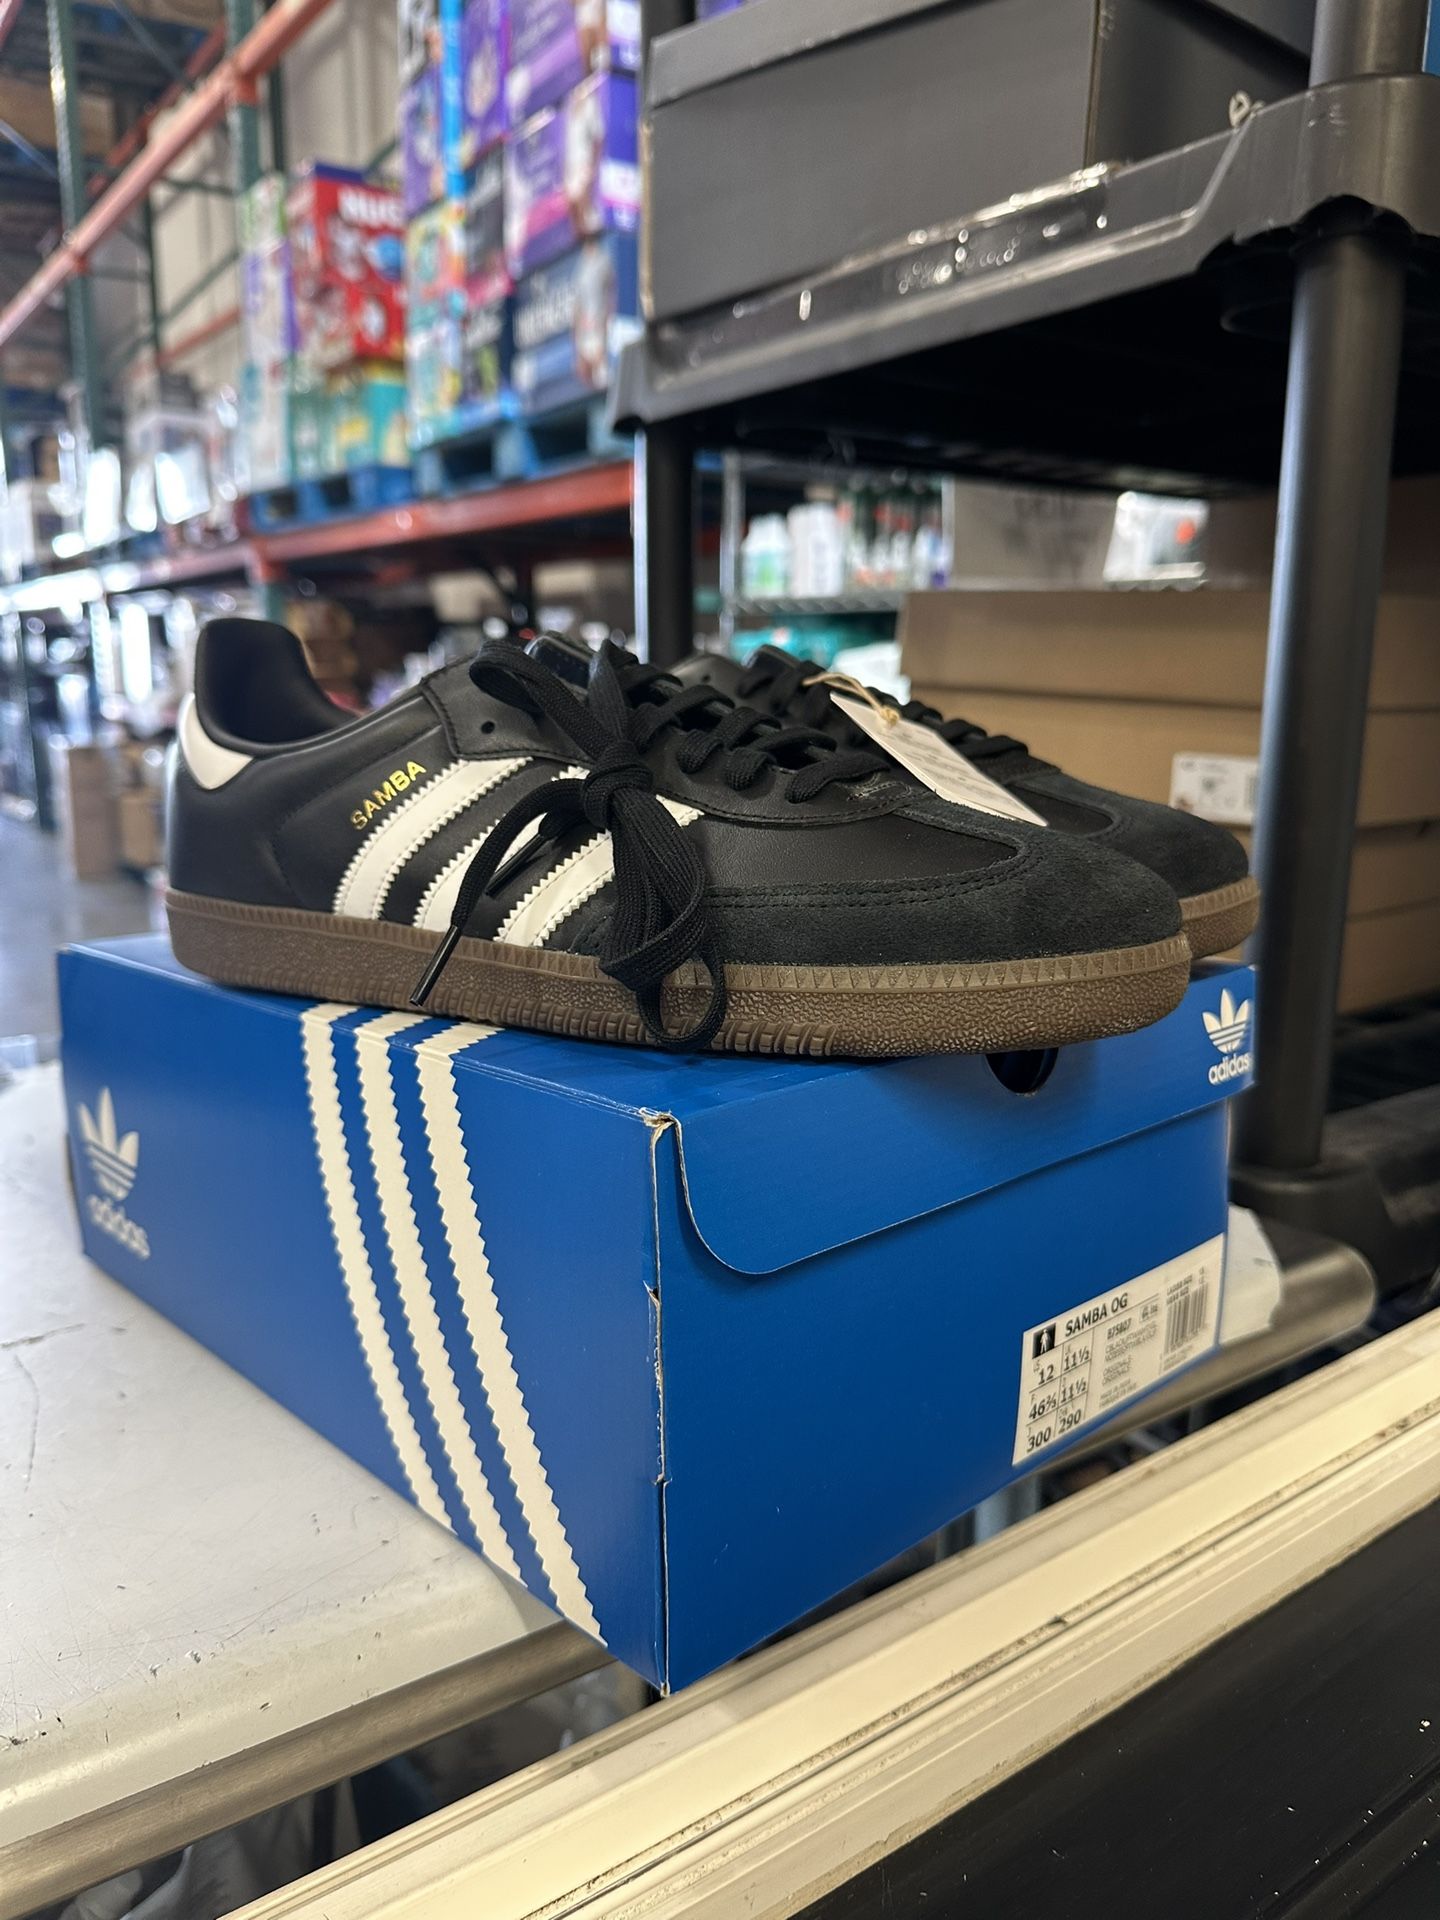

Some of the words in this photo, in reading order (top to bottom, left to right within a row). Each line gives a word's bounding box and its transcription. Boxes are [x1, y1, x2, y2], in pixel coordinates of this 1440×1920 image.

[351, 761, 427, 830] SAMBA
[1208, 1053, 1251, 1085] adidas
[88, 1194, 151, 1261] adidas
[1065, 1306, 1107, 1337] SAMBA
[1111, 1293, 1128, 1313] OG
[1038, 1364, 1054, 1385] 12
[1058, 1409, 1082, 1434] 290
[1027, 1427, 1052, 1453] 300
